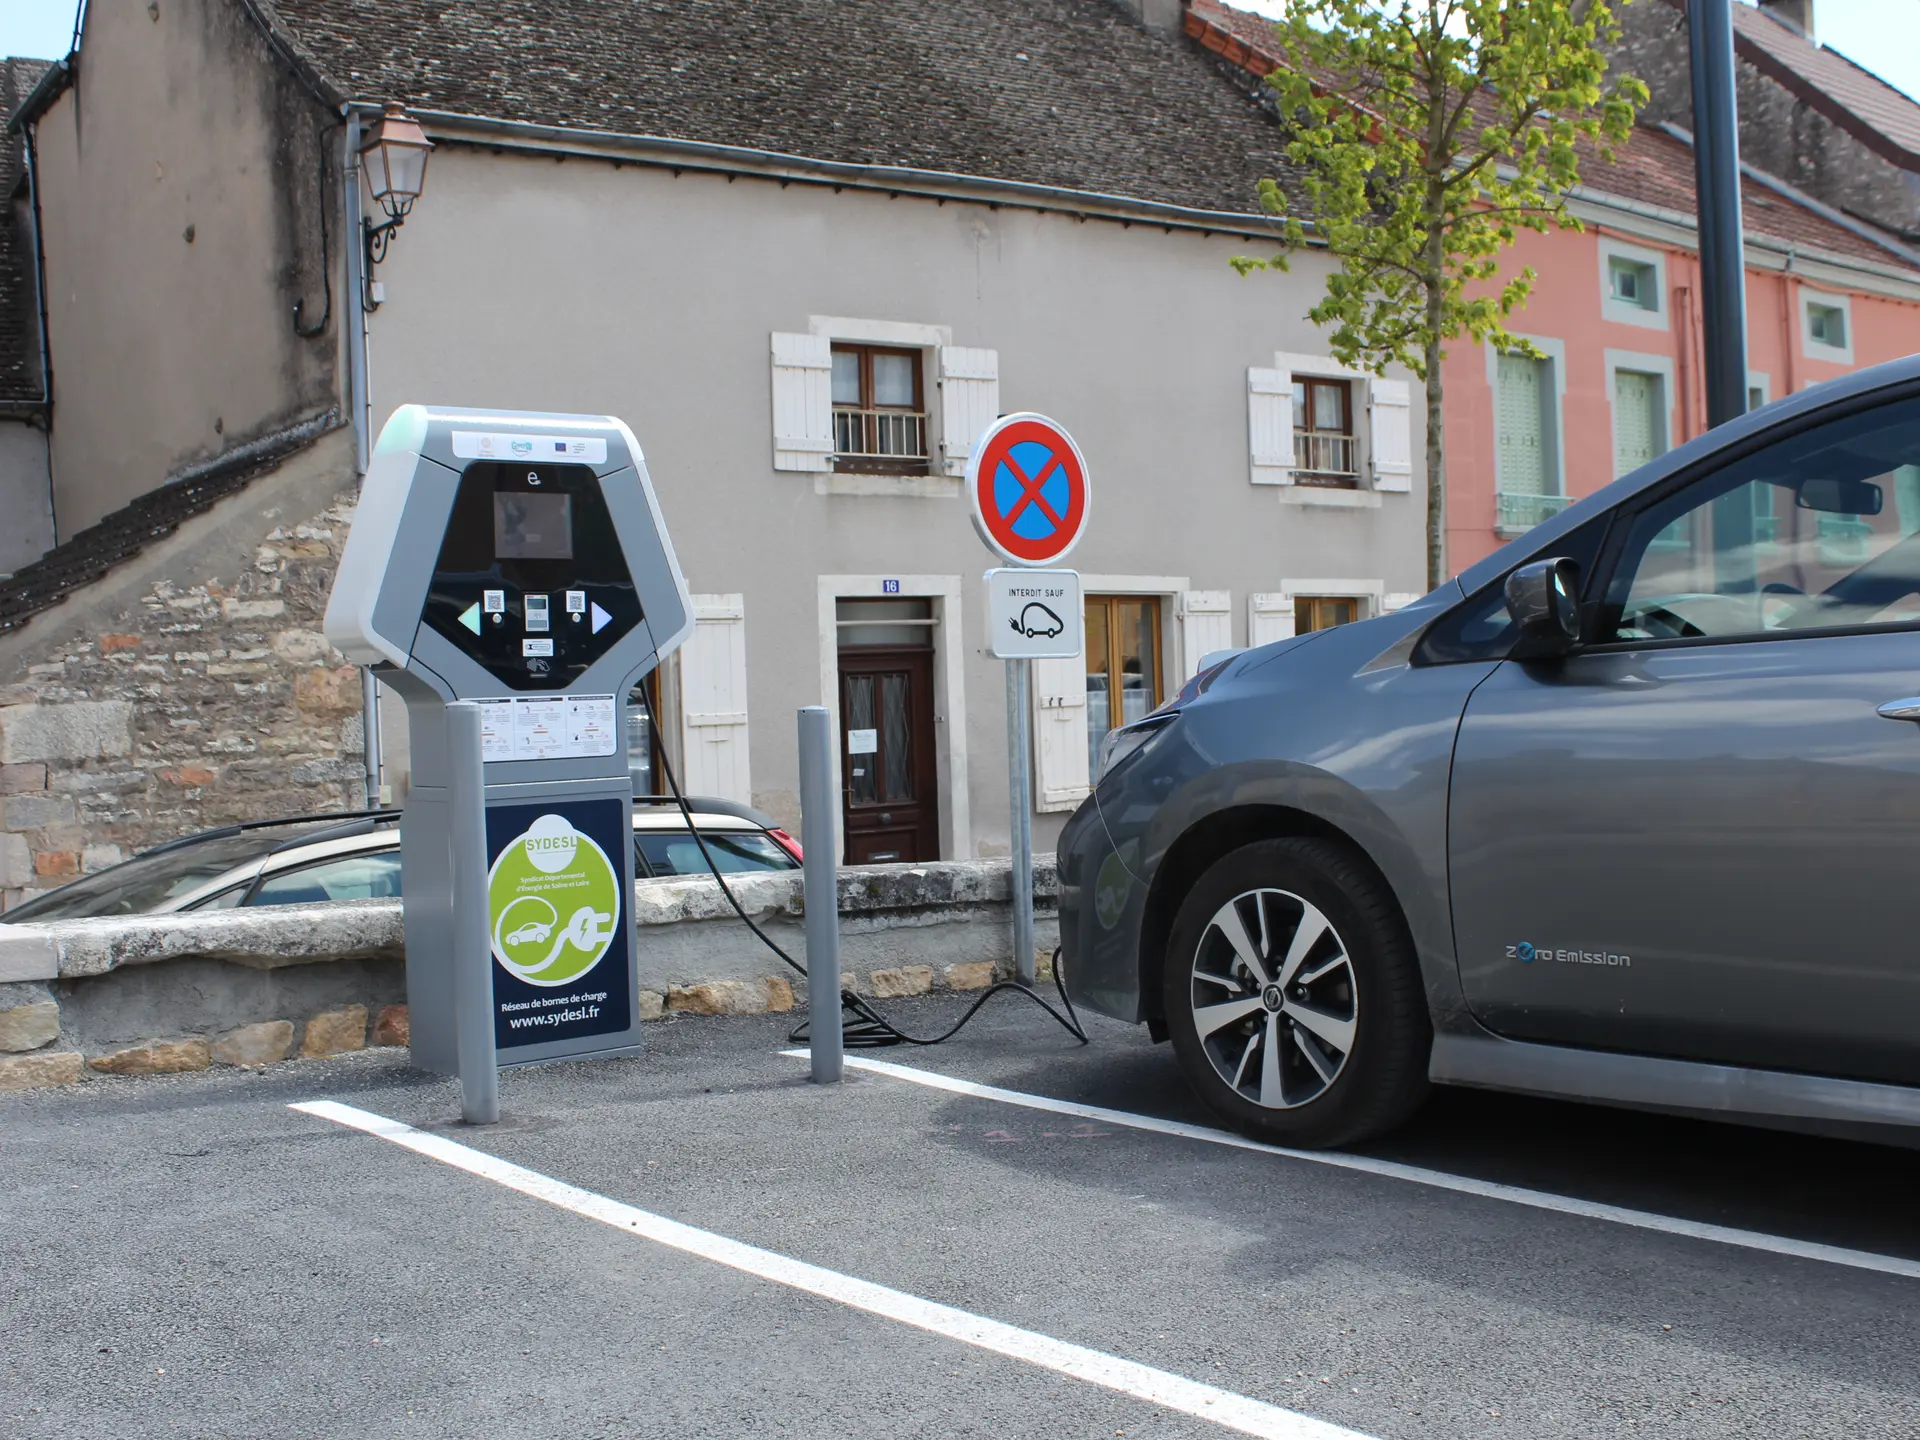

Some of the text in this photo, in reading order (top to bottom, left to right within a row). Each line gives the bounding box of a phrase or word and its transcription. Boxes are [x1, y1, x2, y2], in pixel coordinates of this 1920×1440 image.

[885, 581, 897, 592] 16
[1008, 588, 1064, 597] INTERDIT SAUF
[527, 836, 577, 851] SYDESL
[520, 876, 544, 884] Syndicat
[1556, 949, 1631, 966] Emission
[501, 991, 607, 1012] Réseau de bornes de charge
[510, 1005, 600, 1029] www.sydesl.fr
